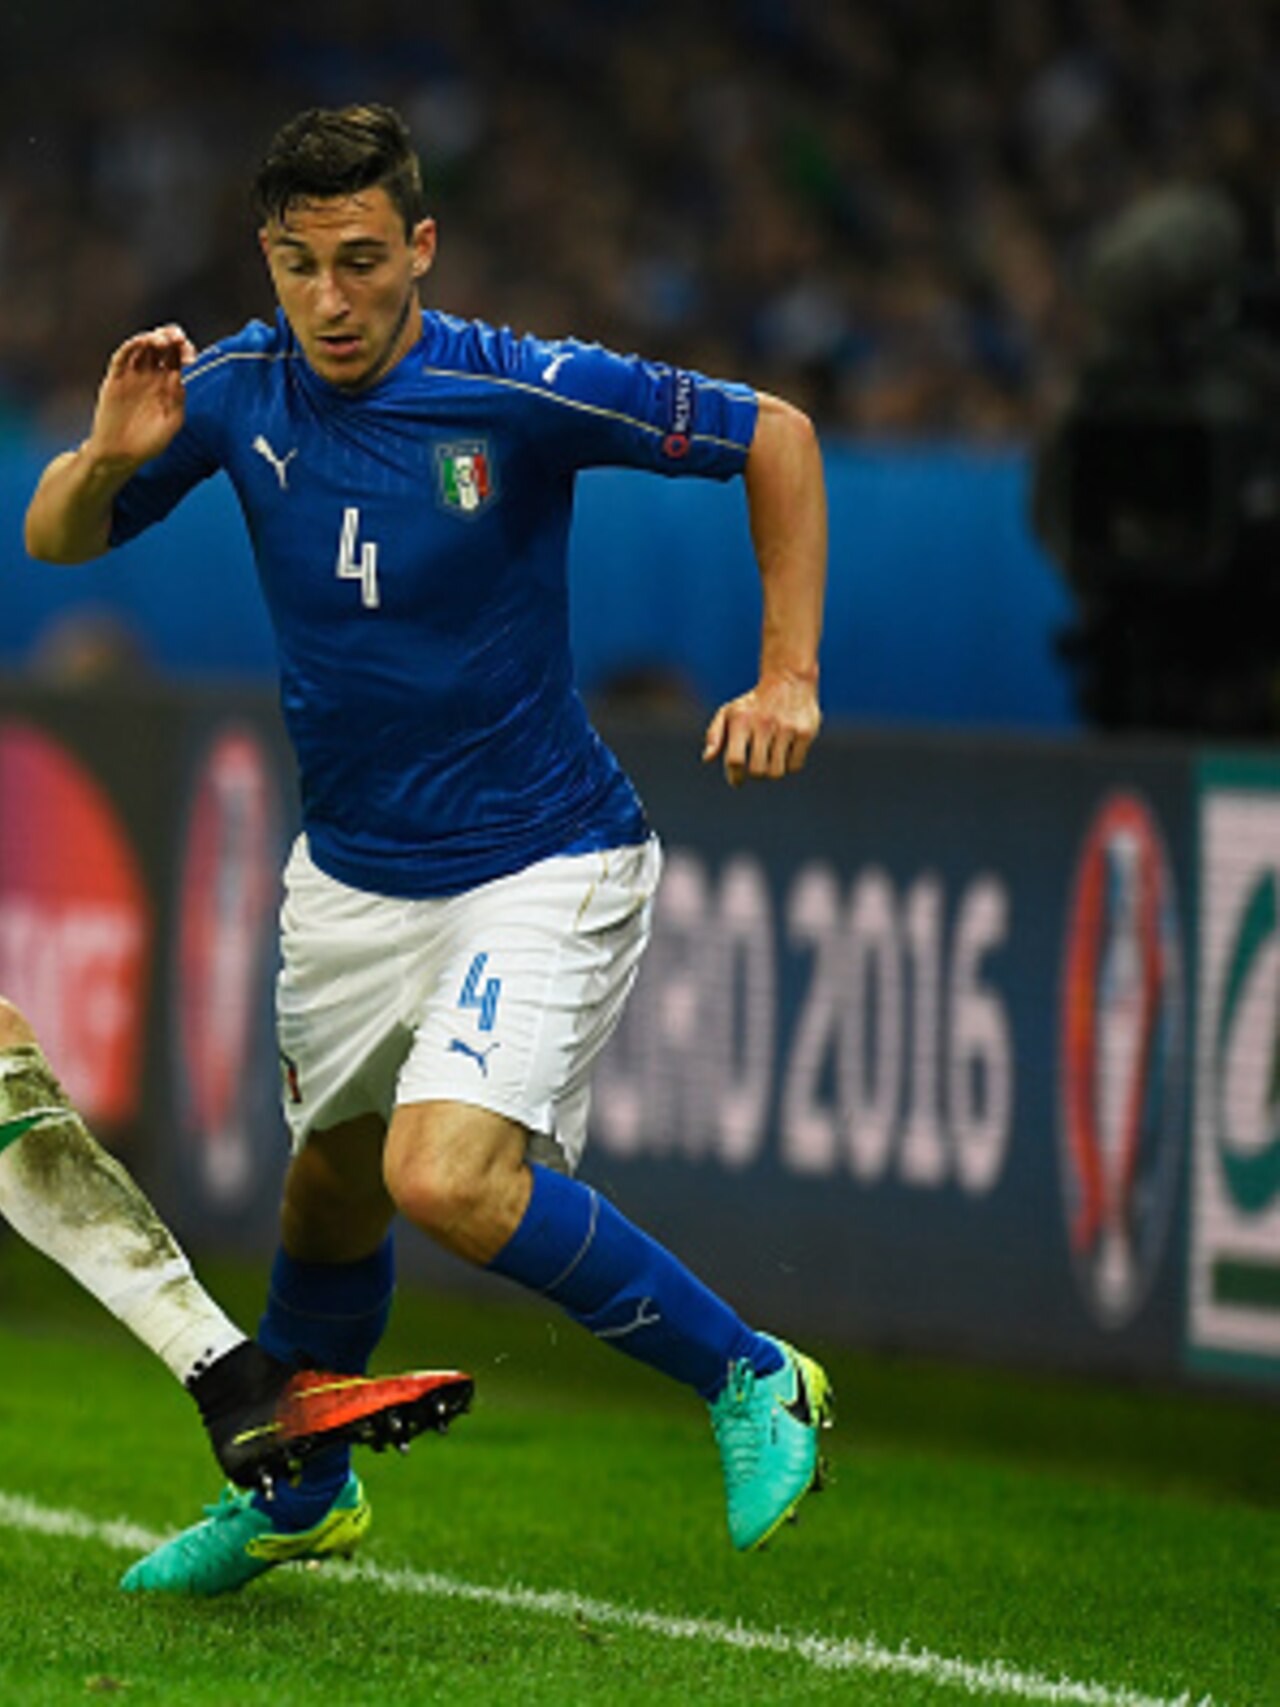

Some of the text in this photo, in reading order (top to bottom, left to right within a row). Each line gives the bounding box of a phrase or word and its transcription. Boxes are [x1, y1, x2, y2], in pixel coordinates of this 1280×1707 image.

[335, 506, 380, 610] 4
[458, 951, 502, 1032] 4
[784, 858, 1014, 1196] 2016
